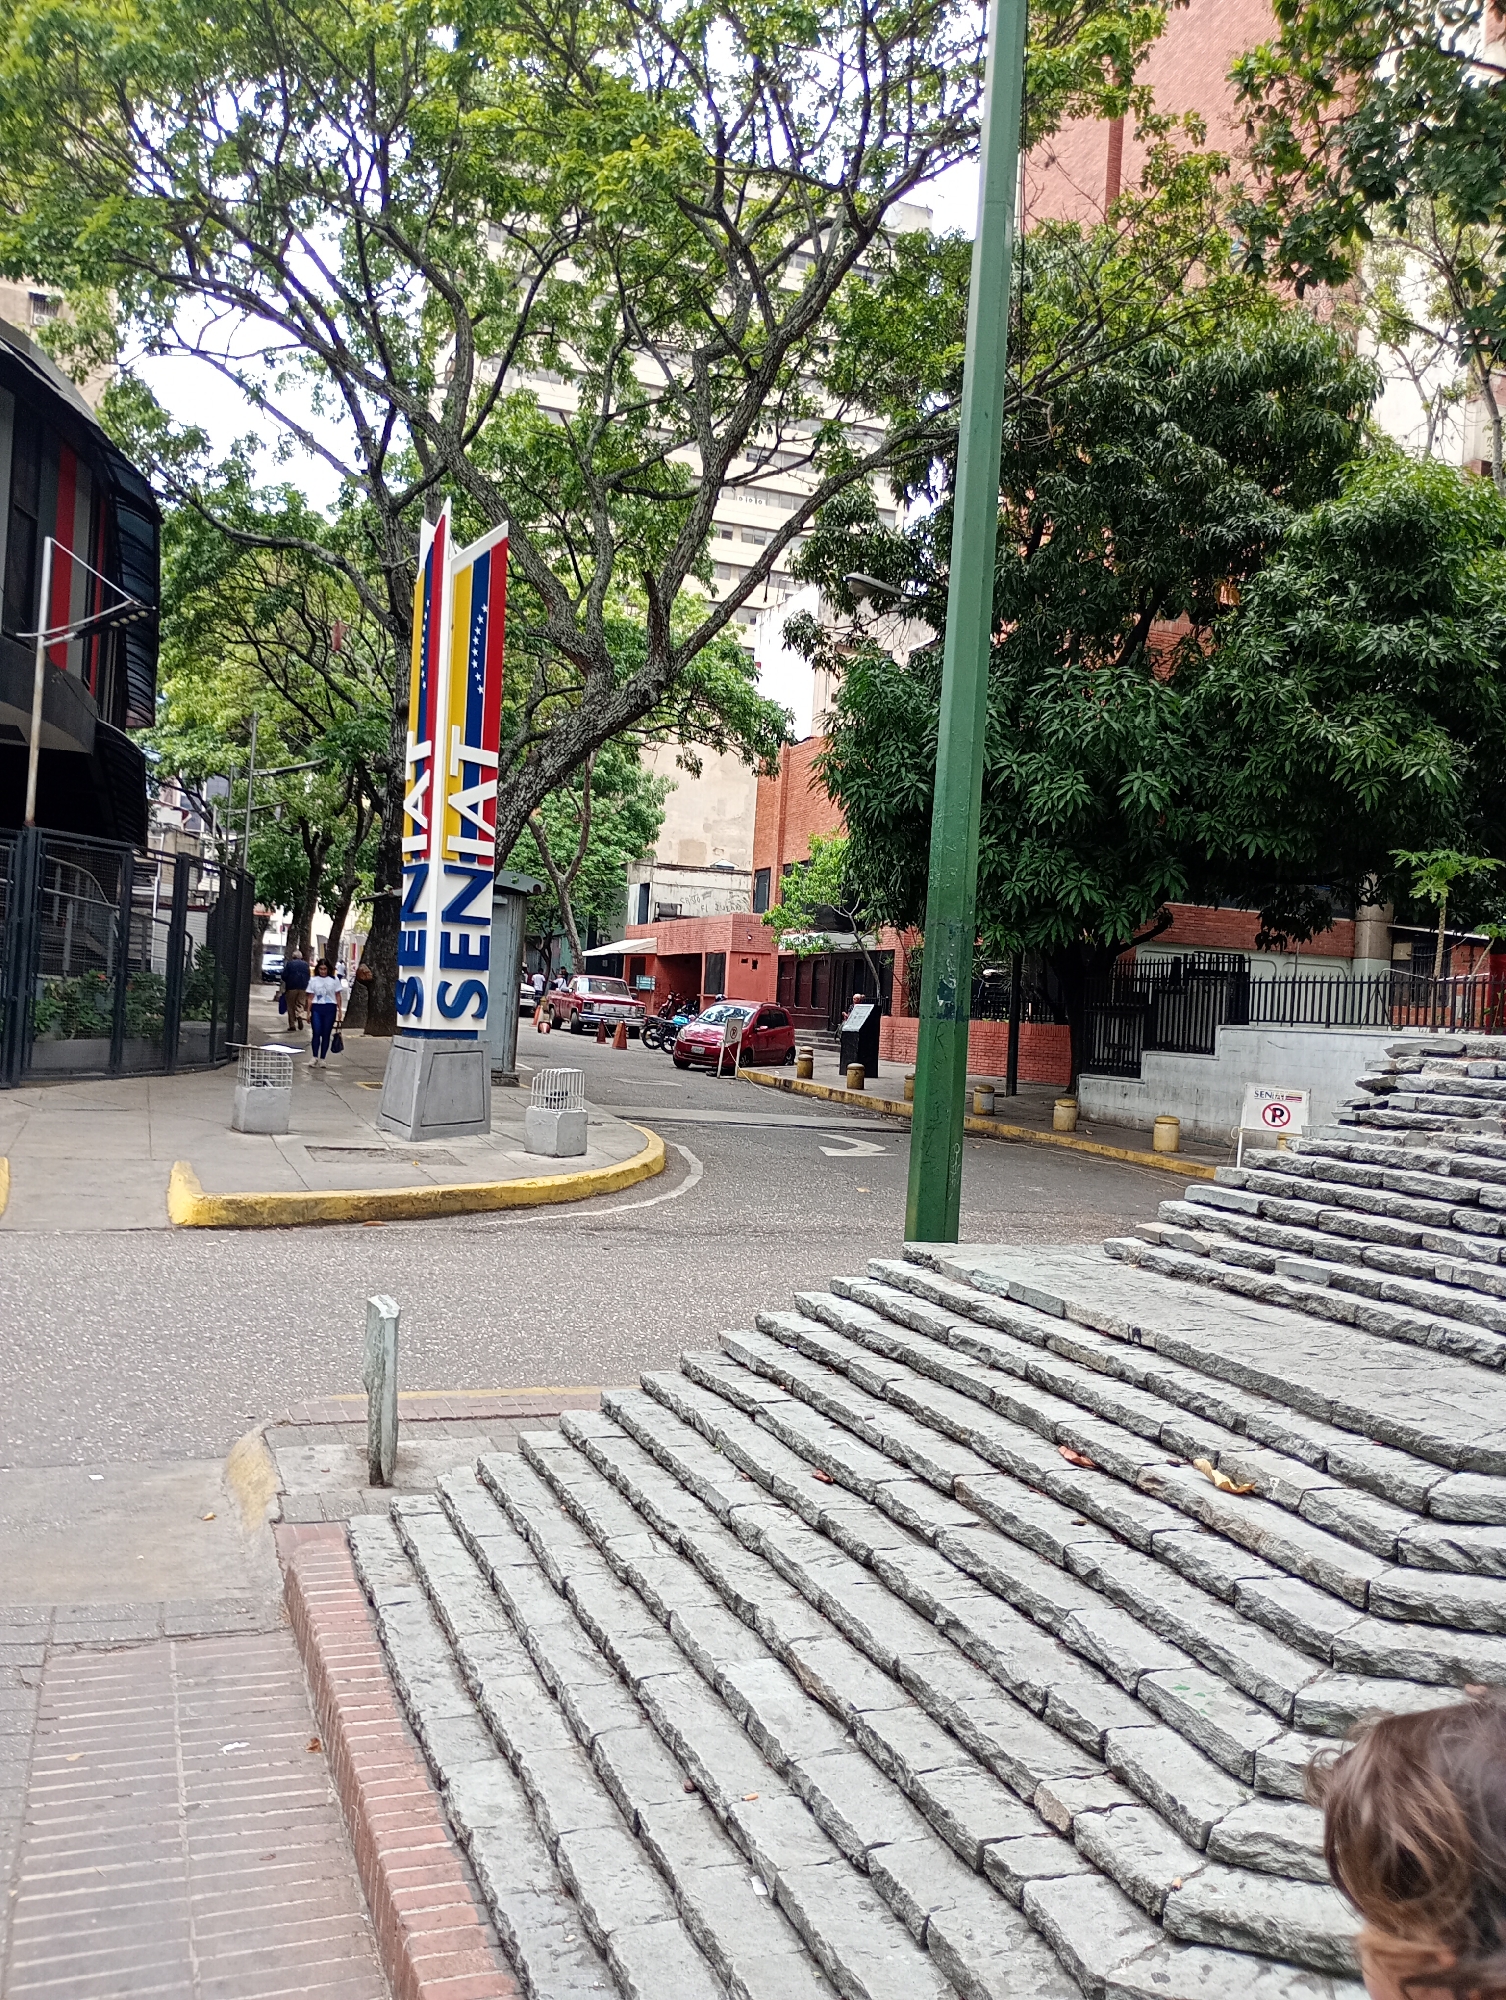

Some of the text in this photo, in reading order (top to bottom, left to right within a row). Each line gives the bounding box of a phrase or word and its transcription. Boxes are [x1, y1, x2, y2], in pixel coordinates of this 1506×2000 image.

[395, 730, 432, 1018] SENIAT
[437, 724, 499, 1020] SENIAT
[1271, 1107, 1284, 1123] P
